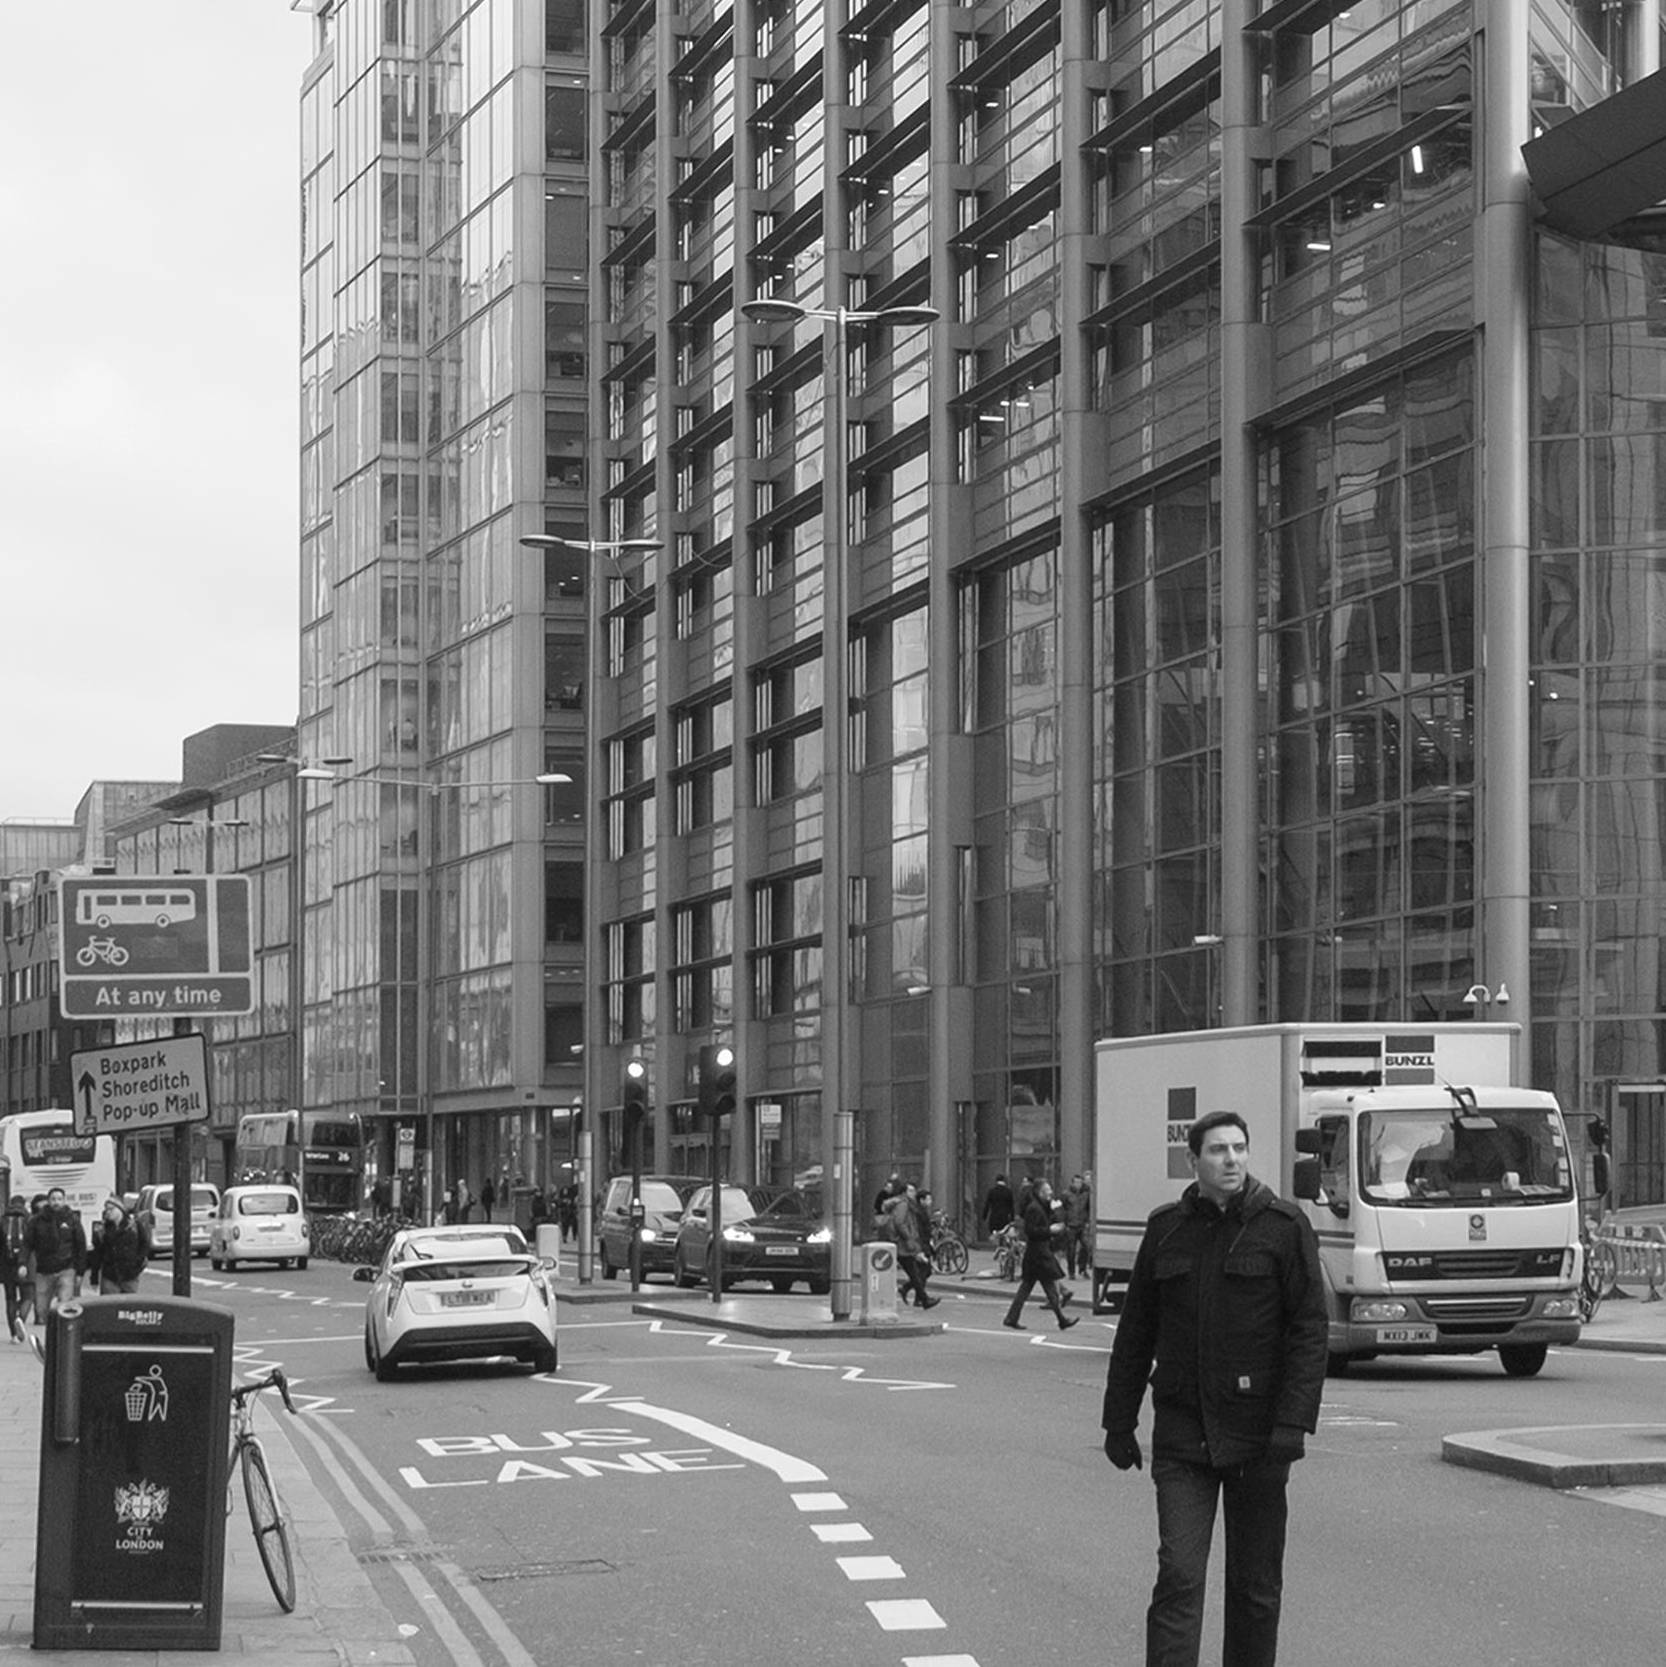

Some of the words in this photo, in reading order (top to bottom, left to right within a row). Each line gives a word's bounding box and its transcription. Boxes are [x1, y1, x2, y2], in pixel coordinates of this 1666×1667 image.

[95, 987, 121, 1006] At
[128, 989, 166, 1008] any
[174, 985, 222, 1004] time
[100, 1051, 167, 1075] Boxpark
[1385, 1055, 1435, 1067] BUNZL
[102, 1071, 190, 1098] Shoreditch
[103, 1100, 159, 1121] Pop-up
[165, 1092, 200, 1114] Mall
[1167, 1123, 1190, 1143] BUNZ
[337, 1151, 350, 1162] 26
[1388, 1257, 1432, 1267] DAF
[1536, 1253, 1561, 1264] LF
[416, 1428, 651, 1456] BUS
[399, 1448, 746, 1488] LANE
[127, 1526, 153, 1536] CITY
[116, 1539, 164, 1550] LONDON
